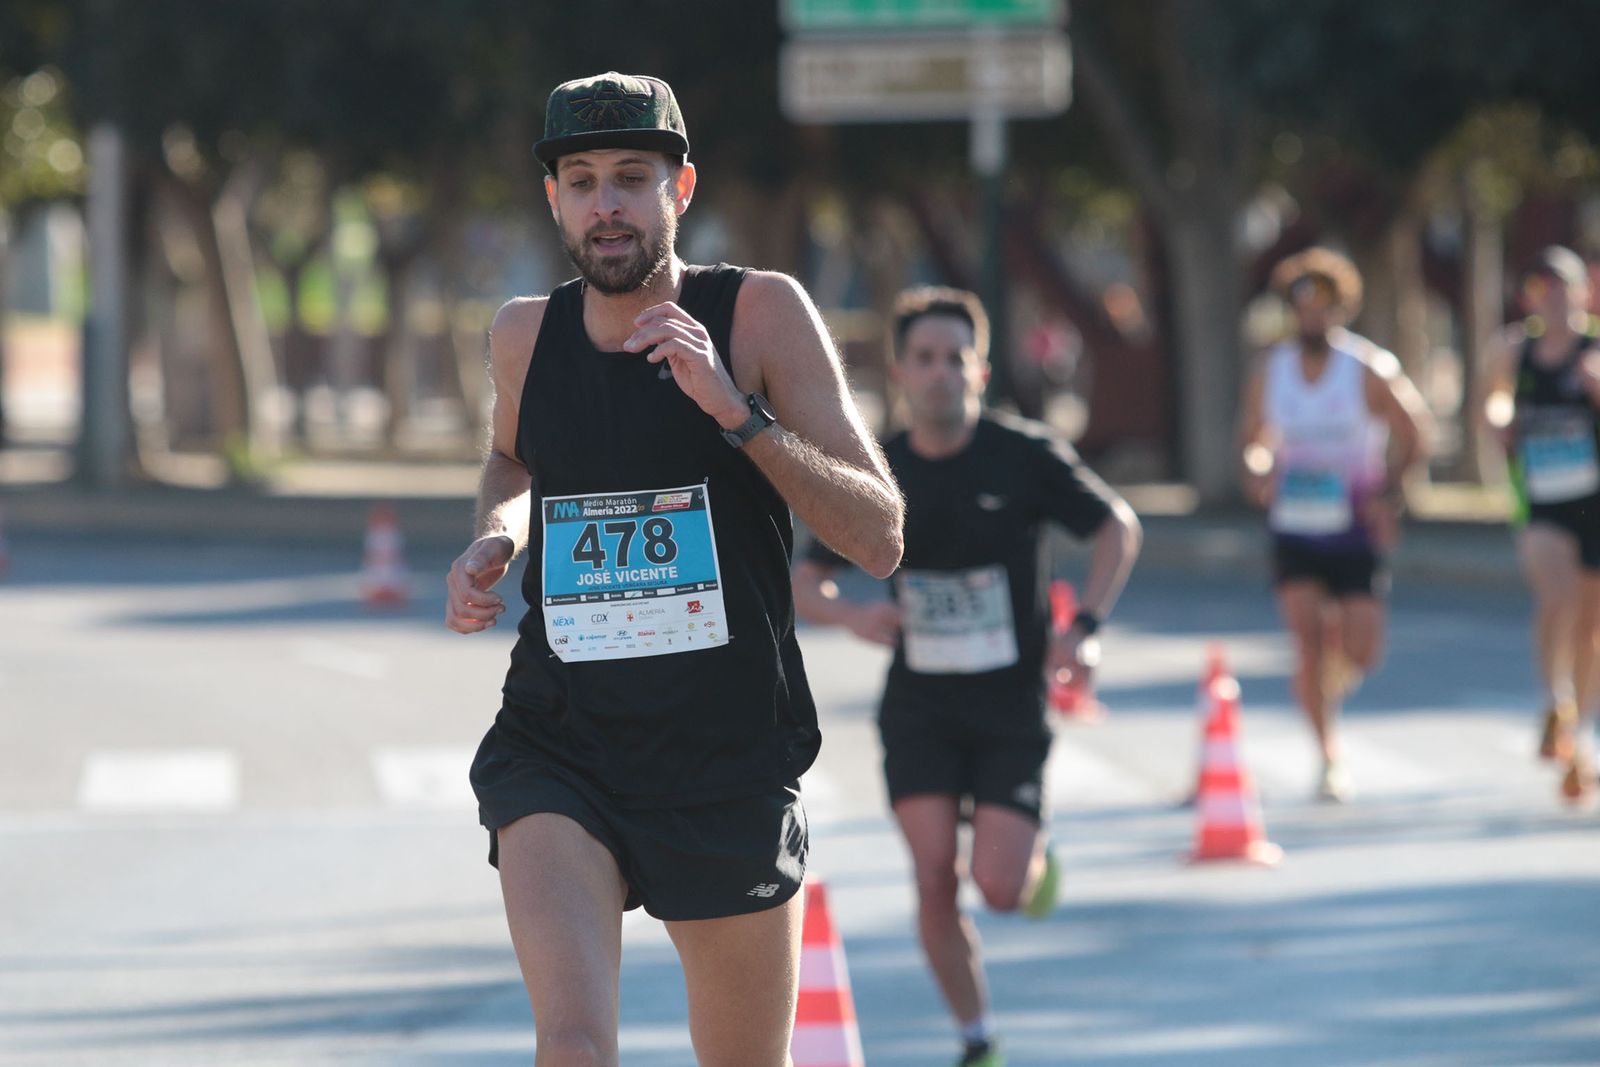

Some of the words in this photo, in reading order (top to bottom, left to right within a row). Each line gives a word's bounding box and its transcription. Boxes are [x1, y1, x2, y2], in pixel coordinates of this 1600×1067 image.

[583, 499, 604, 507] Medio
[605, 497, 637, 506] Maratón
[583, 506, 613, 517] Almería
[614, 505, 638, 515] 2022
[571, 517, 679, 571] 478
[576, 569, 612, 587] JOSÉ
[615, 566, 679, 583] VICENTE
[552, 616, 575, 627] NEXA
